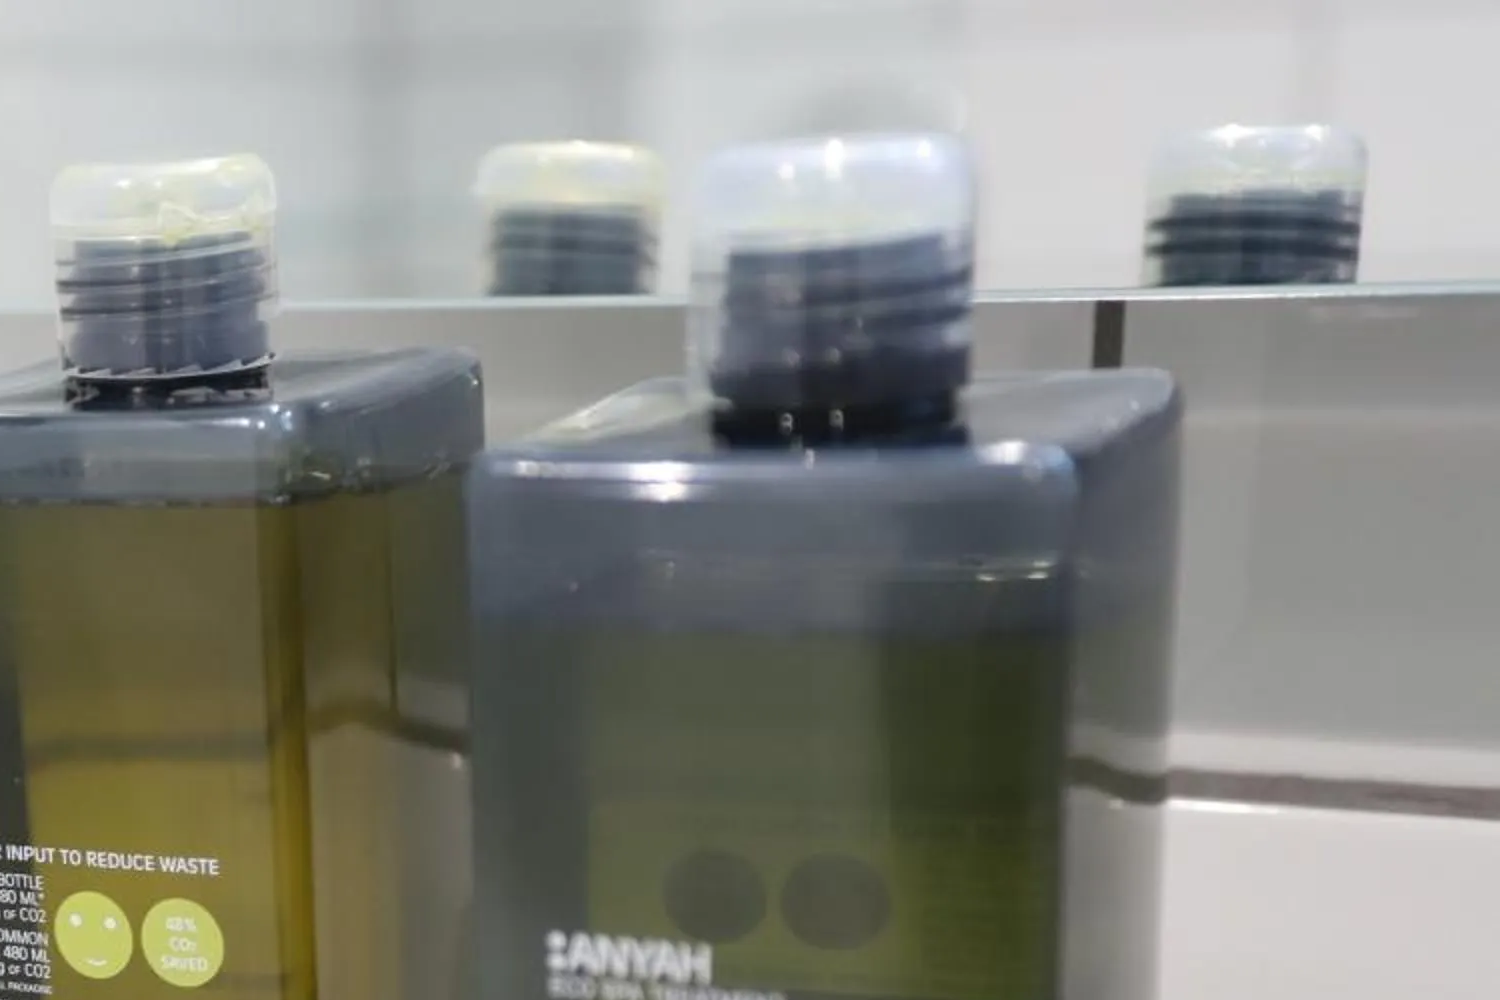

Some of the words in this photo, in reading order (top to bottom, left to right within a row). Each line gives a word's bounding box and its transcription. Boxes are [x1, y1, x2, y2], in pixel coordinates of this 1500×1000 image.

[6, 845, 54, 863] INPUT
[61, 849, 81, 866] TO
[87, 852, 154, 871] REDUCE
[159, 856, 219, 876] WASTE
[20, 908, 47, 923] CO2
[4, 944, 29, 961] 480
[32, 948, 50, 963] ML
[25, 962, 51, 979] CO2
